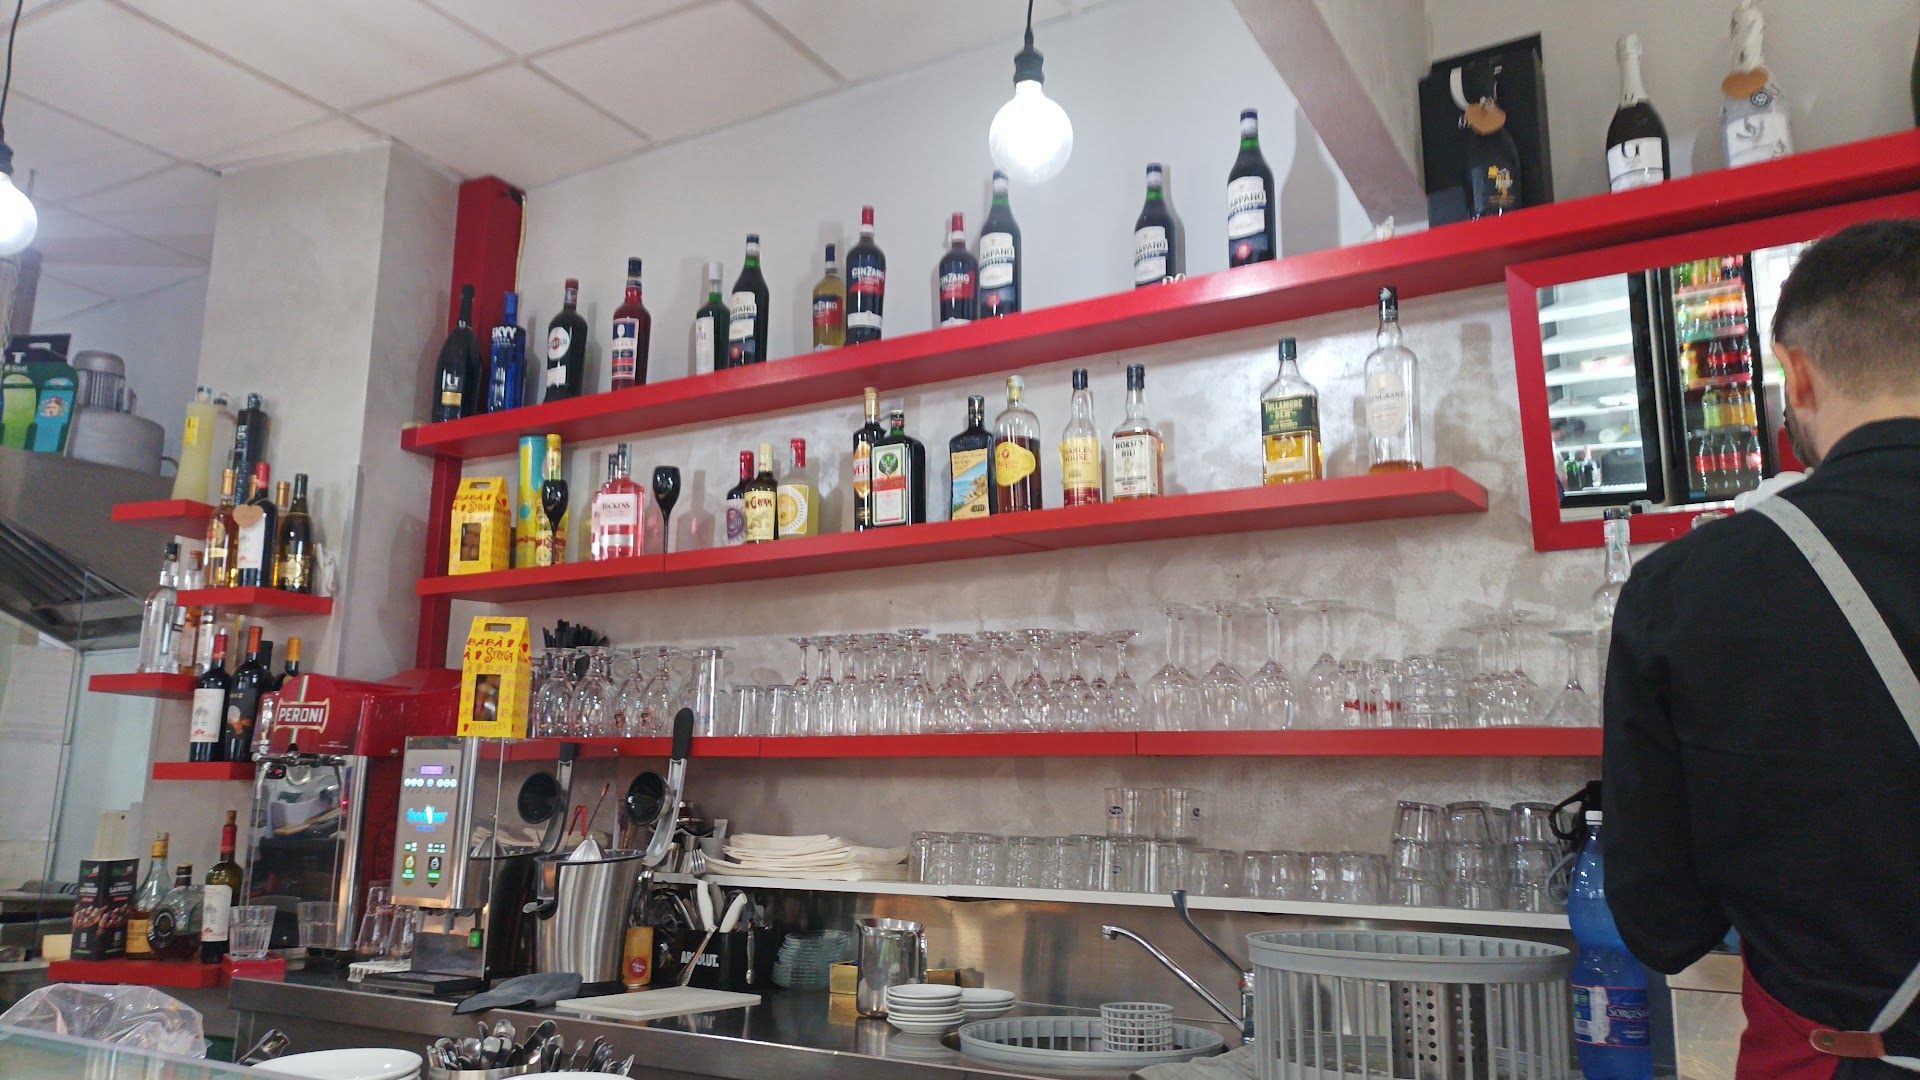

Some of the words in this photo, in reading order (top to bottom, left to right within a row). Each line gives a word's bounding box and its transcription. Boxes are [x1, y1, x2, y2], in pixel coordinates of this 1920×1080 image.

[1229, 192, 1264, 207] ARPANO
[982, 247, 1013, 258] ARPANO
[1136, 240, 1166, 255] ARPANO
[941, 273, 970, 289] INZANO
[492, 326, 517, 339] SKYY
[1265, 399, 1303, 414] TULLAMORE
[1275, 409, 1291, 420] DEW
[467, 636, 503, 648] BABÀ
[278, 707, 325, 723] PERONI
[681, 950, 720, 968] ABOLUT.
